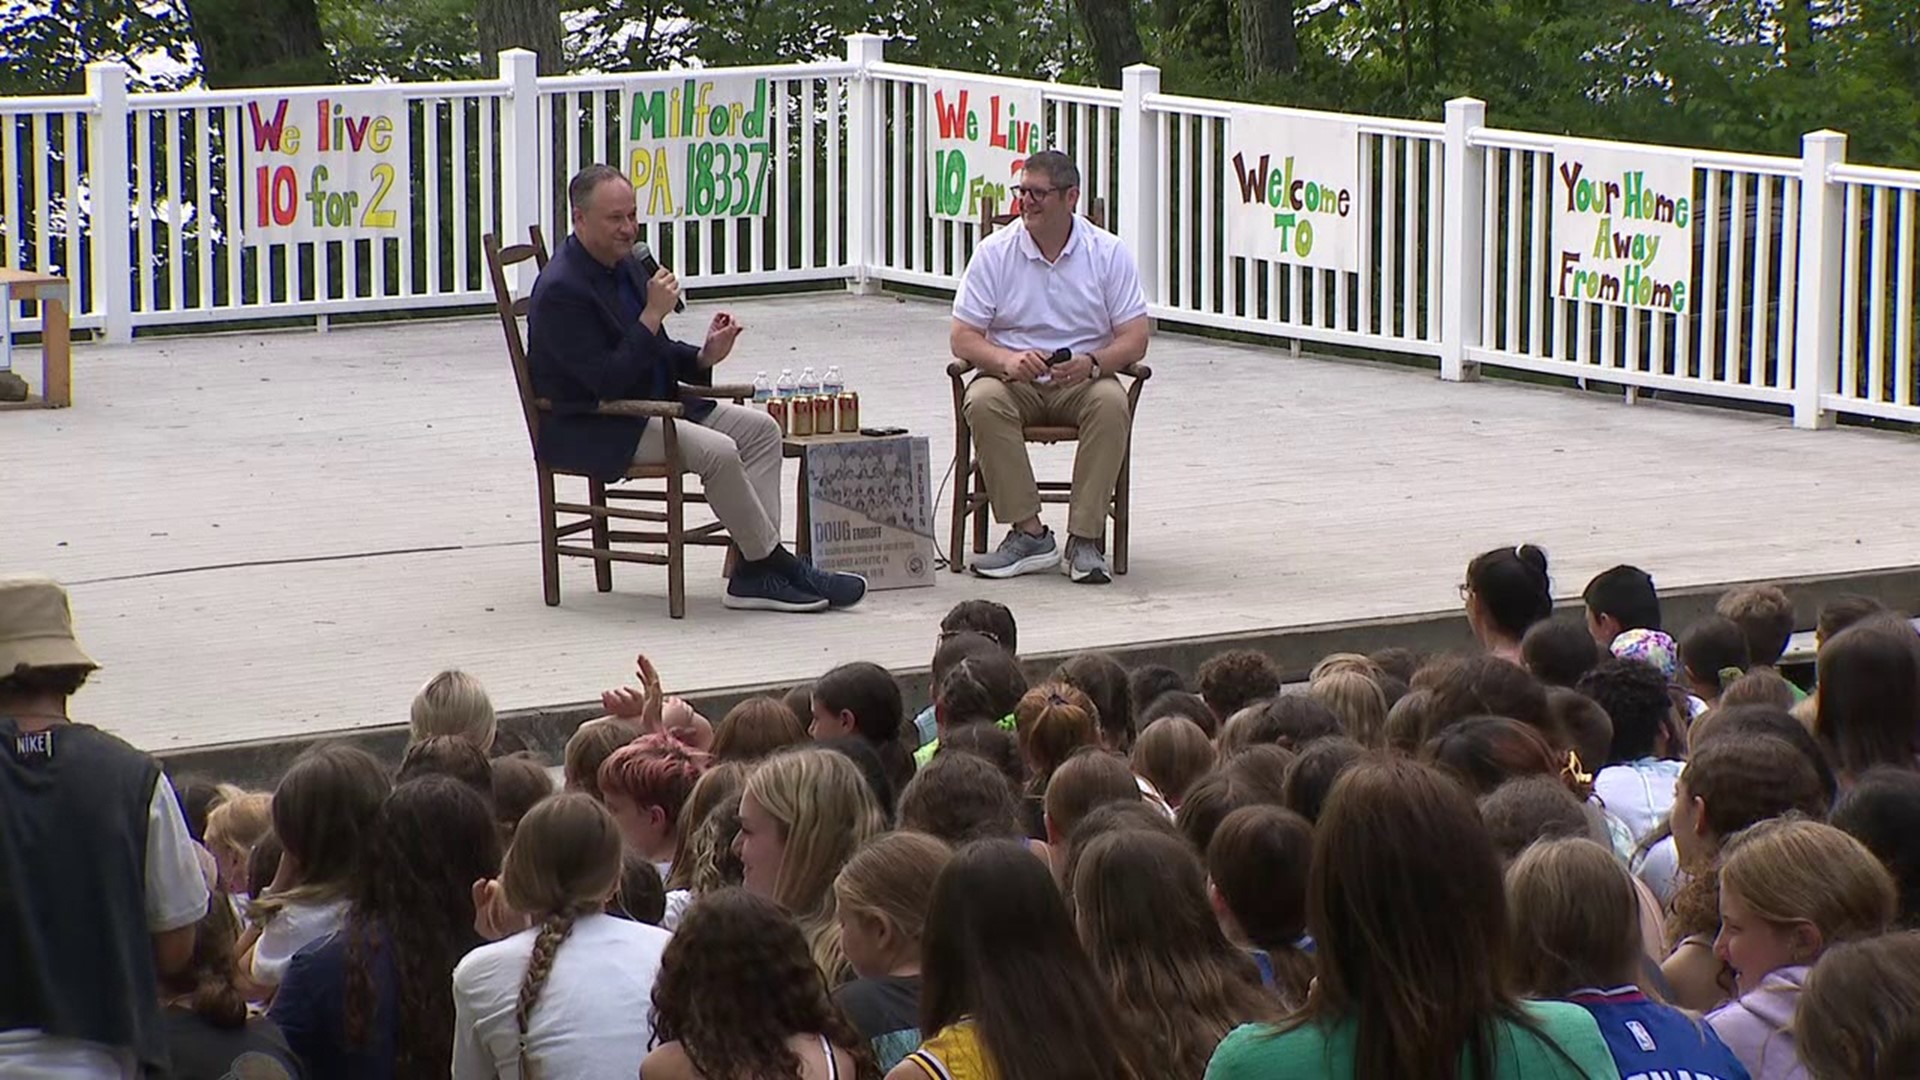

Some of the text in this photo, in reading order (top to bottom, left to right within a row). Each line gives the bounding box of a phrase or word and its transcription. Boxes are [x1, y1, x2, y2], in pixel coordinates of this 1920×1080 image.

[248, 99, 393, 155] We live
[630, 78, 766, 141] Milford
[934, 89, 1039, 155] We Live
[256, 163, 396, 228] 10 for 2
[685, 142, 768, 216] 18337
[935, 149, 966, 216] 10
[1232, 152, 1350, 217] Welcome
[1560, 161, 1688, 228] Your Home
[1593, 217, 1660, 269] Away
[1559, 251, 1685, 312] From Home
[815, 520, 850, 543] DOUG
[17, 734, 45, 753] NIKE
